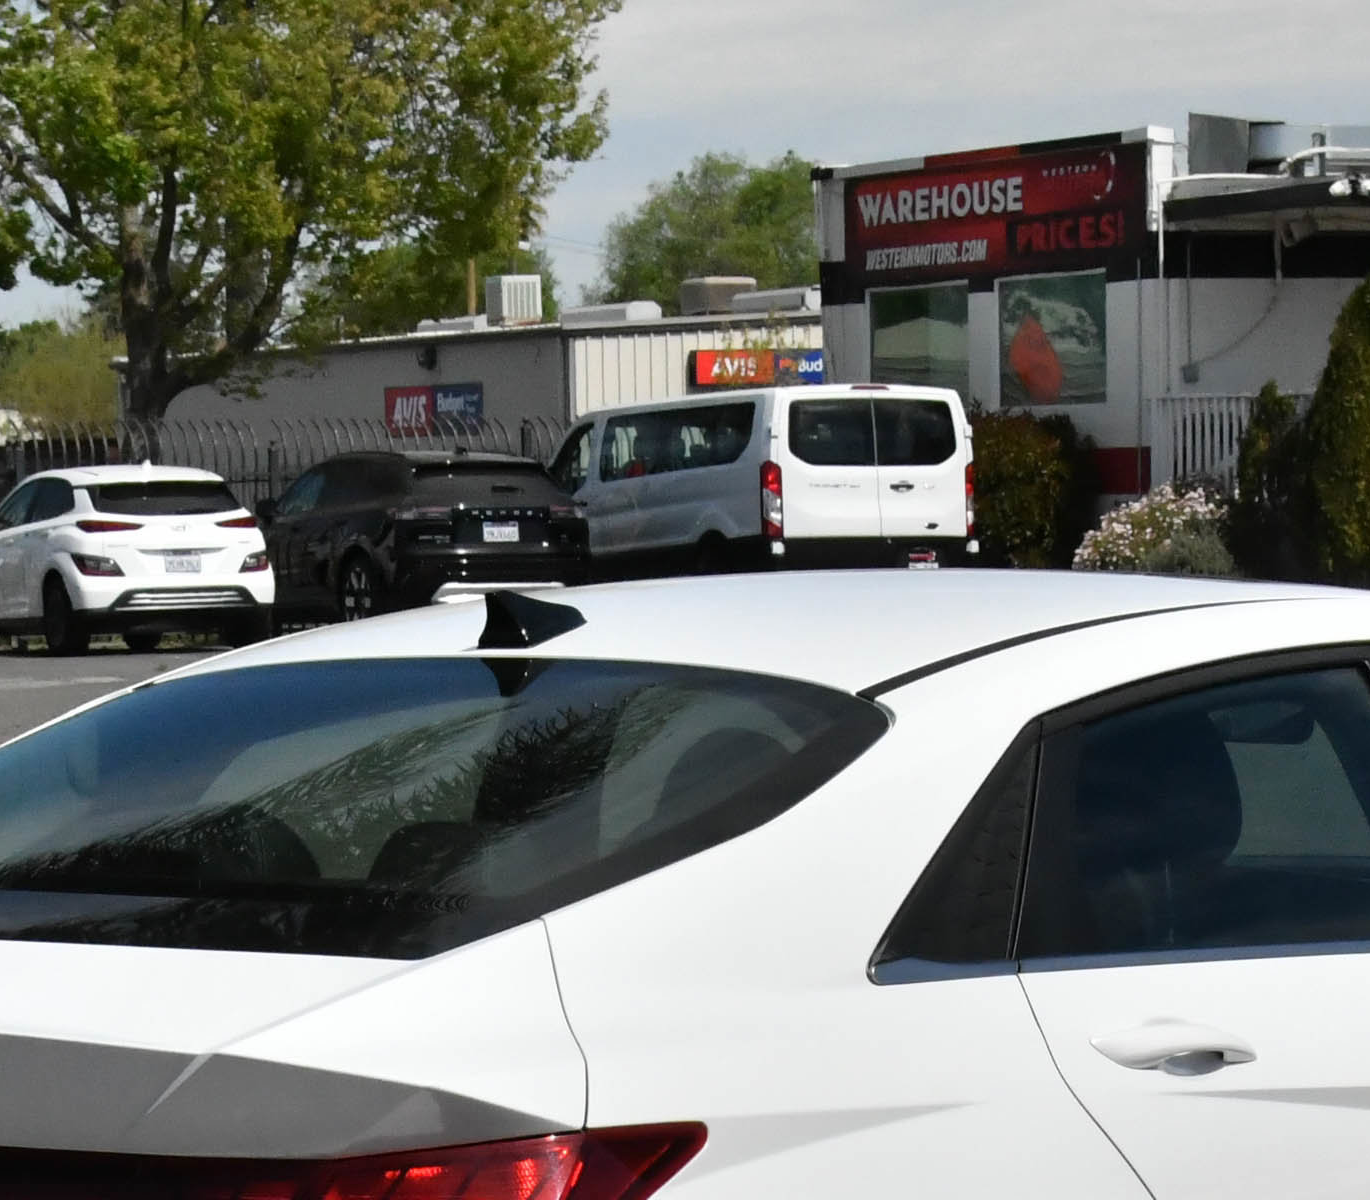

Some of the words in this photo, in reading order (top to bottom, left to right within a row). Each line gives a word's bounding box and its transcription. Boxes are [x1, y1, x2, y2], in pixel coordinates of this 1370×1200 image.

[858, 177, 1023, 227] WAREHOUSE
[1016, 209, 1125, 254] PRICES!
[865, 239, 988, 271] WESTERNMOTORS.COM
[711, 356, 758, 377] AVIS
[392, 395, 427, 428] AVIS
